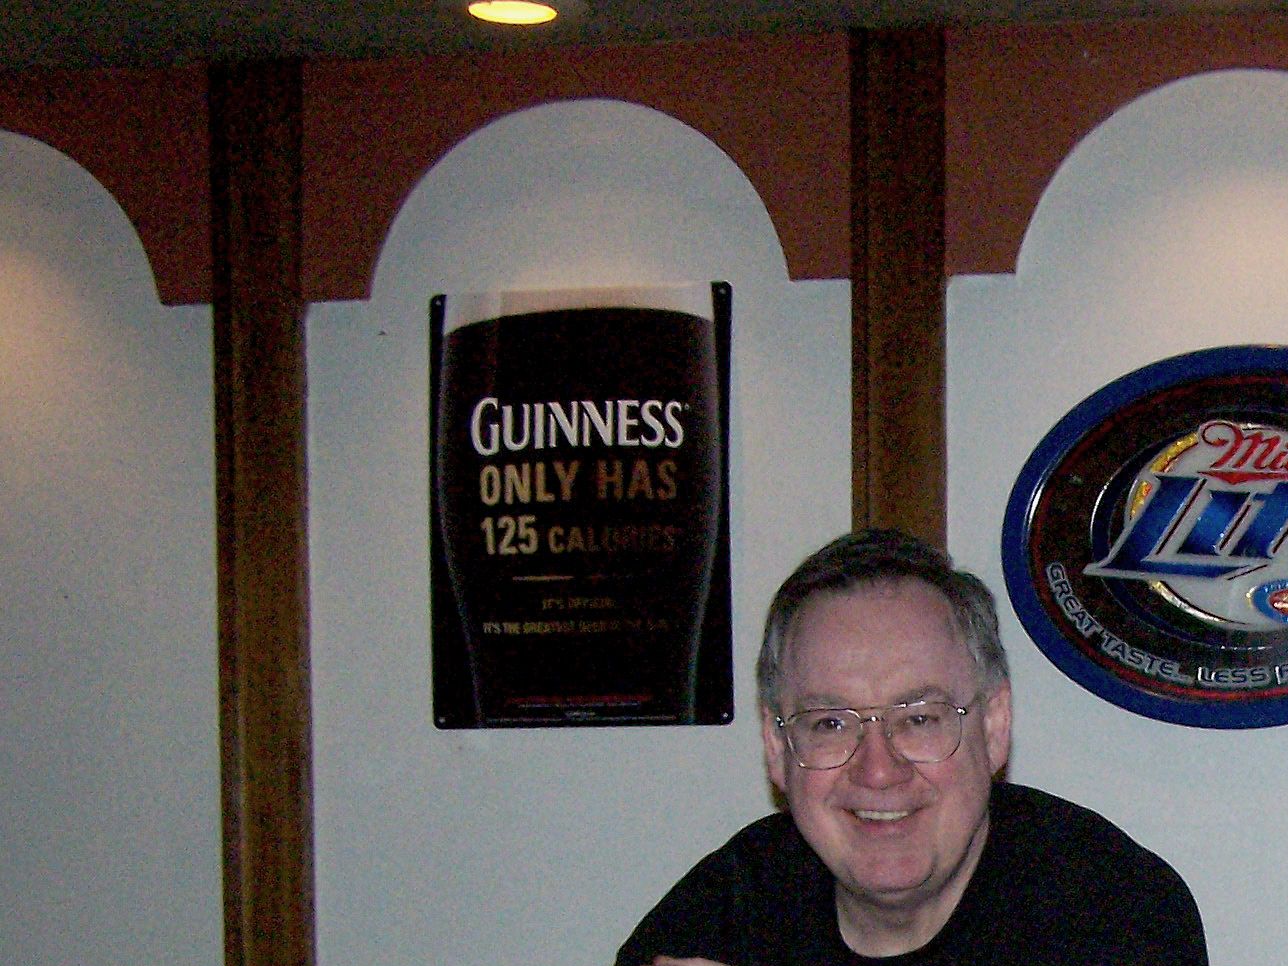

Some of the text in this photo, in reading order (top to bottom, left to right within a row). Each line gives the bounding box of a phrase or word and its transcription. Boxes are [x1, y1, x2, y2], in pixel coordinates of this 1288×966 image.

[470, 397, 686, 456] GUINNESS
[478, 458, 679, 506] ONLY HAS
[480, 515, 540, 556] 125
[1047, 562, 1099, 638] GREAT
[1198, 666, 1268, 686] LESS
